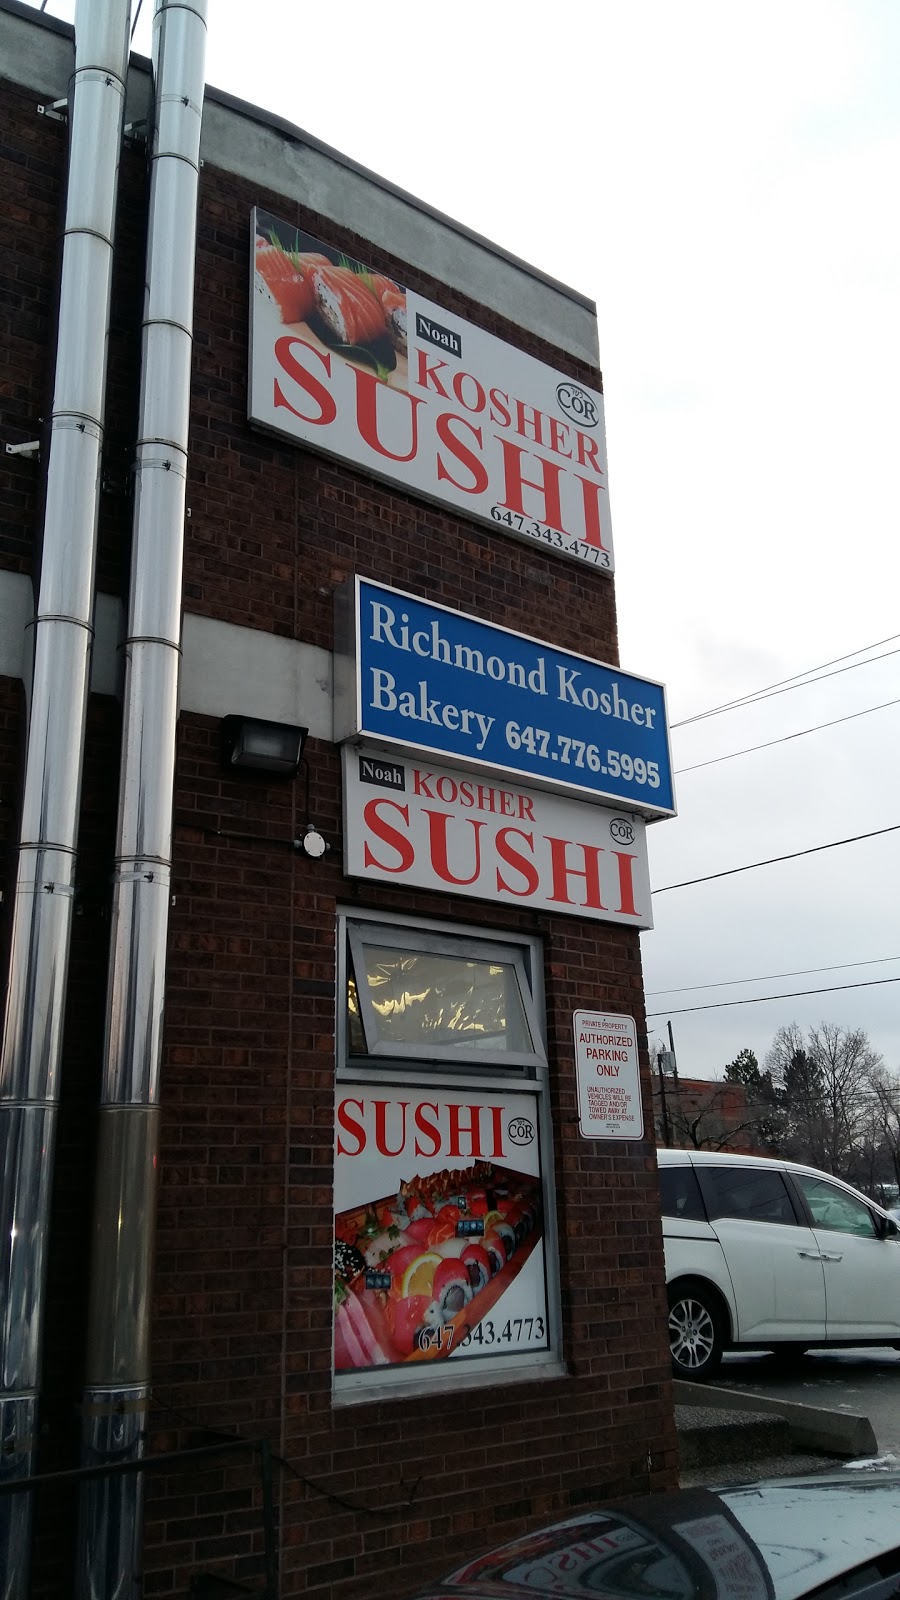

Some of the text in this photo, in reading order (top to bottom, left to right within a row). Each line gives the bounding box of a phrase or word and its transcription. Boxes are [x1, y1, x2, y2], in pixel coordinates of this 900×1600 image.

[418, 316, 460, 353] Noah
[414, 347, 604, 475] KOSHER
[558, 388, 599, 423] COR
[273, 335, 611, 553] SUSHI
[490, 506, 611, 568] 647.343.4773
[369, 601, 656, 729] Richmond Kosher
[369, 668, 661, 789] Bakery 647.776.5995
[361, 761, 537, 822] Noah KOSHER
[610, 823, 635, 841] COR
[363, 798, 643, 917] SUSHI
[582, 1019, 628, 1031] PRIVATE PROPERTY
[579, 1032, 633, 1048] AUTHORIZED
[586, 1047, 629, 1063] PARKING
[596, 1064, 620, 1078] ONLY
[586, 1086, 626, 1094] UNAUTHORIZED
[587, 1092, 612, 1101] VEHICLES
[588, 1099, 628, 1108] TAGGED ANDOR
[589, 1106, 607, 1114] TOWED
[607, 1107, 621, 1115] AWAY
[336, 1097, 508, 1159] SUSHI
[588, 1113, 635, 1122] OWNERS EXPENSE
[508, 1123, 535, 1140] COR
[418, 1316, 546, 1353] 647.343.4773
